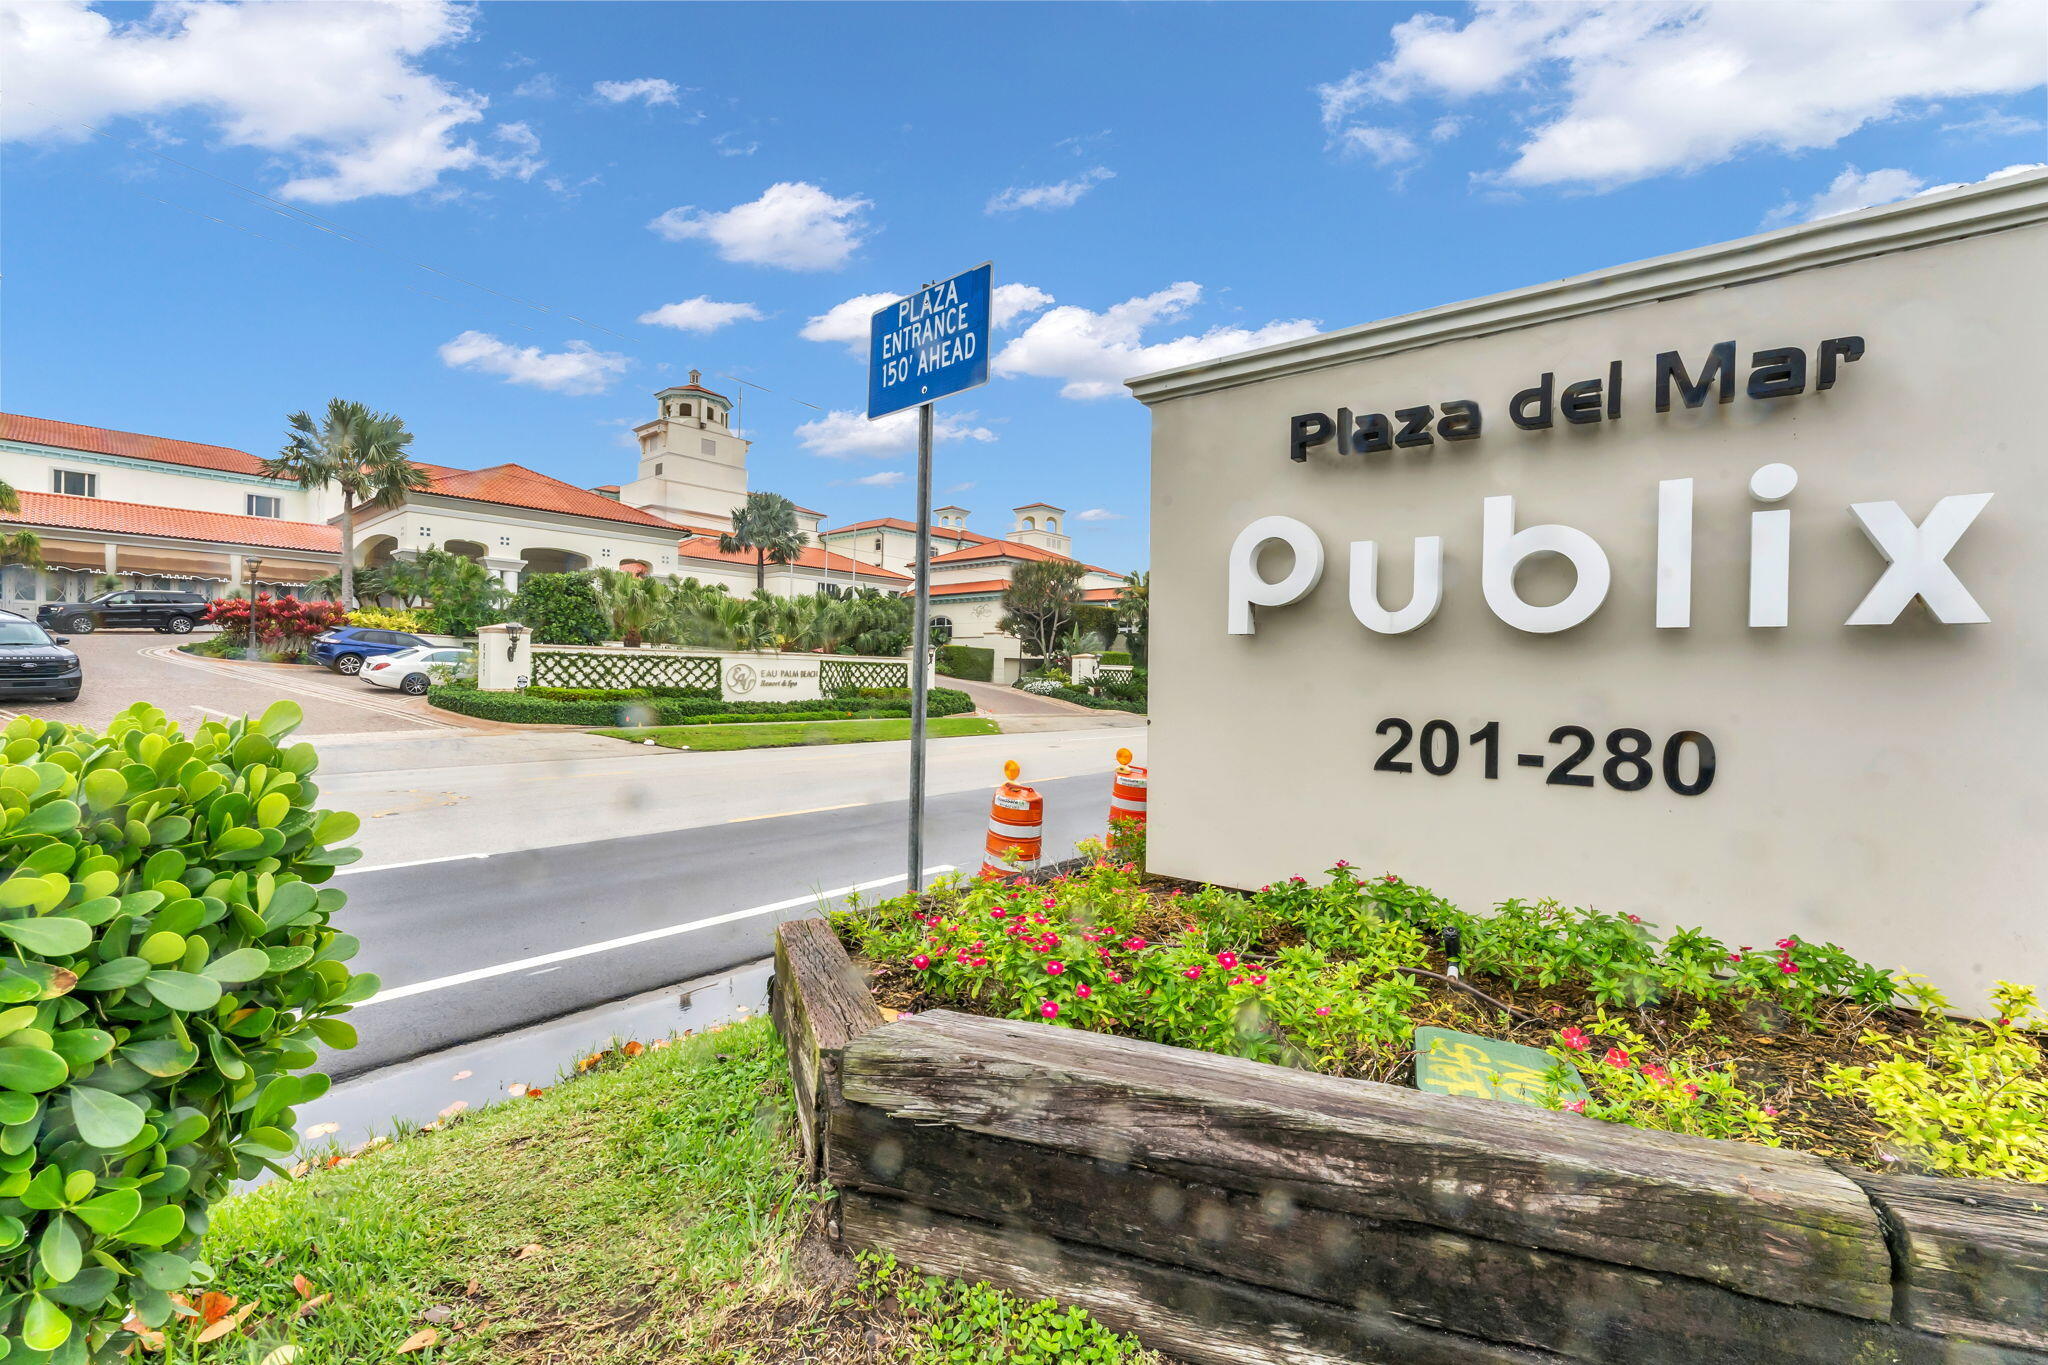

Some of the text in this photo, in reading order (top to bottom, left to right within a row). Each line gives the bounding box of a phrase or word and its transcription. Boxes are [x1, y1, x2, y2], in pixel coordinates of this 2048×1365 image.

[883, 303, 968, 359] ENTRANCE
[899, 280, 958, 327] PLAZA
[882, 332, 976, 388] 150' AHEAD
[1290, 336, 1865, 463] Plaza del Mar
[760, 670, 819, 679] EAU PALM BEACH
[1373, 718, 1717, 797] 201-280
